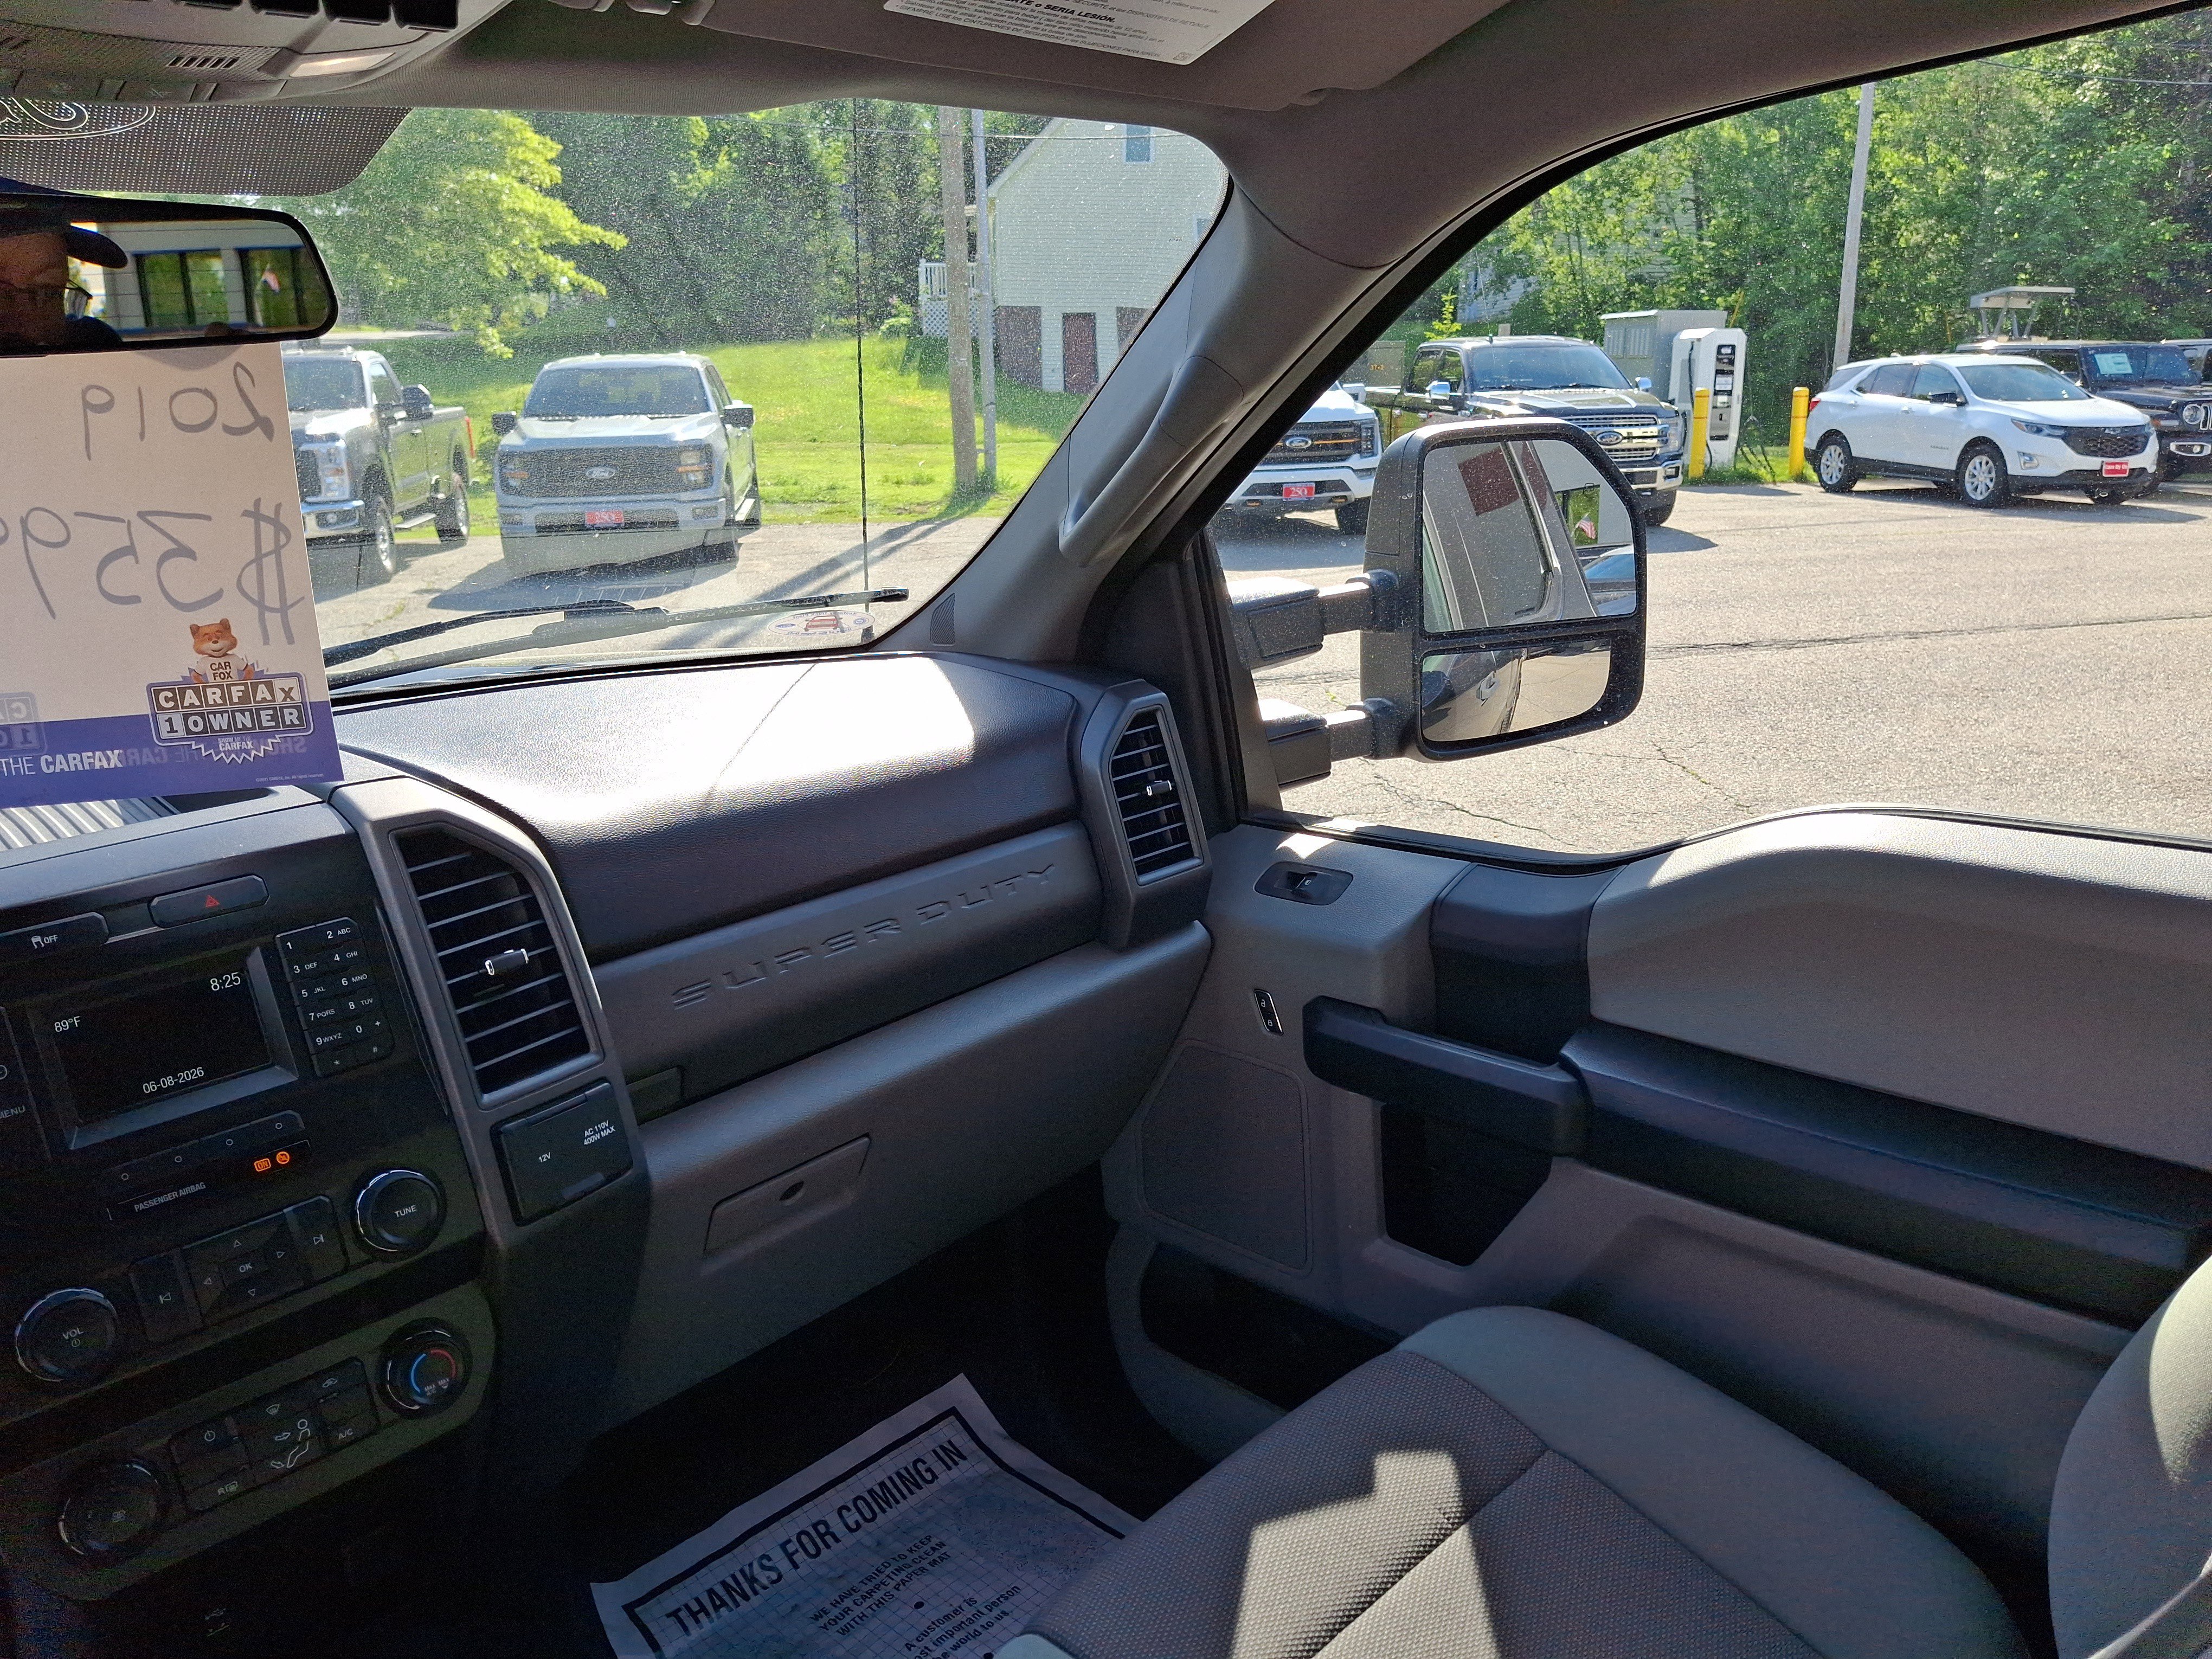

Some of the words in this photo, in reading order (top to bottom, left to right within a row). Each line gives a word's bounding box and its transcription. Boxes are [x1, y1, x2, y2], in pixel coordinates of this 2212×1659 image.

[1044, 4, 1075, 15] SERIA
[210, 661, 232, 671] CAR
[212, 671, 234, 681] FOX
[158, 684, 295, 708] CARFAX
[218, 741, 254, 751] CARFAX
[0, 757, 36, 776] THE
[44, 934, 59, 944] OFF
[326, 930, 334, 939] 2
[337, 927, 351, 936] ABC
[672, 917, 902, 1011] SUPER
[917, 863, 1054, 924] DUTY
[286, 942, 293, 950] 1
[334, 954, 340, 962] 4
[346, 950, 358, 959] GHI
[293, 965, 300, 974] 3
[304, 962, 318, 970] DEF
[210, 972, 241, 991] 8:25
[342, 978, 348, 986] 6
[351, 974, 368, 983] MNO
[301, 989, 308, 998] 5
[313, 986, 326, 994] JKL
[349, 1001, 355, 1010] 8
[360, 998, 374, 1006] TUV
[308, 1012, 315, 1021] 7
[316, 1009, 336, 1019] PQRS
[54, 1015, 81, 1032] 89°F
[356, 1025, 363, 1033] 0
[316, 1037, 323, 1045] 9
[323, 1033, 343, 1043] WXYZ
[143, 1066, 205, 1094] 06-08-2026
[584, 1128, 594, 1137] AC
[594, 1120, 609, 1133] 110V
[583, 1133, 600, 1145] 400W
[601, 1126, 615, 1137] MAX
[538, 1152, 551, 1163] 12V
[258, 1160, 268, 1169] ON
[134, 1191, 179, 1212] PASSENGER
[178, 1182, 206, 1197] AIRBAG
[394, 1205, 417, 1218] TUNE
[239, 1263, 253, 1272] OK
[62, 1327, 84, 1340] VOL
[338, 1428, 353, 1440] A/C
[666, 1553, 784, 1636] THANKS
[780, 1519, 841, 1570] FOR
[839, 1458, 940, 1533] COMING
[933, 1439, 968, 1472] IN
[809, 1606, 832, 1621] WE
[829, 1585, 861, 1609] HAVE
[859, 1561, 892, 1586] TRIED
[890, 1553, 908, 1562] TO
[906, 1535, 933, 1554] KEEP
[819, 1606, 854, 1631] YOUR
[852, 1562, 913, 1606] CARPETING
[911, 1541, 947, 1564] CLEAN
[835, 1611, 869, 1636] WITH
[866, 1591, 895, 1613] THIS
[893, 1566, 929, 1592] PAPER
[927, 1551, 952, 1568] MAT
[933, 1609, 986, 1647] important
[983, 1585, 1021, 1613] person
[904, 1642, 916, 1652] A
[916, 1605, 965, 1643] customer
[963, 1597, 978, 1607] is
[950, 1628, 982, 1652] world
[980, 1620, 995, 1630] to
